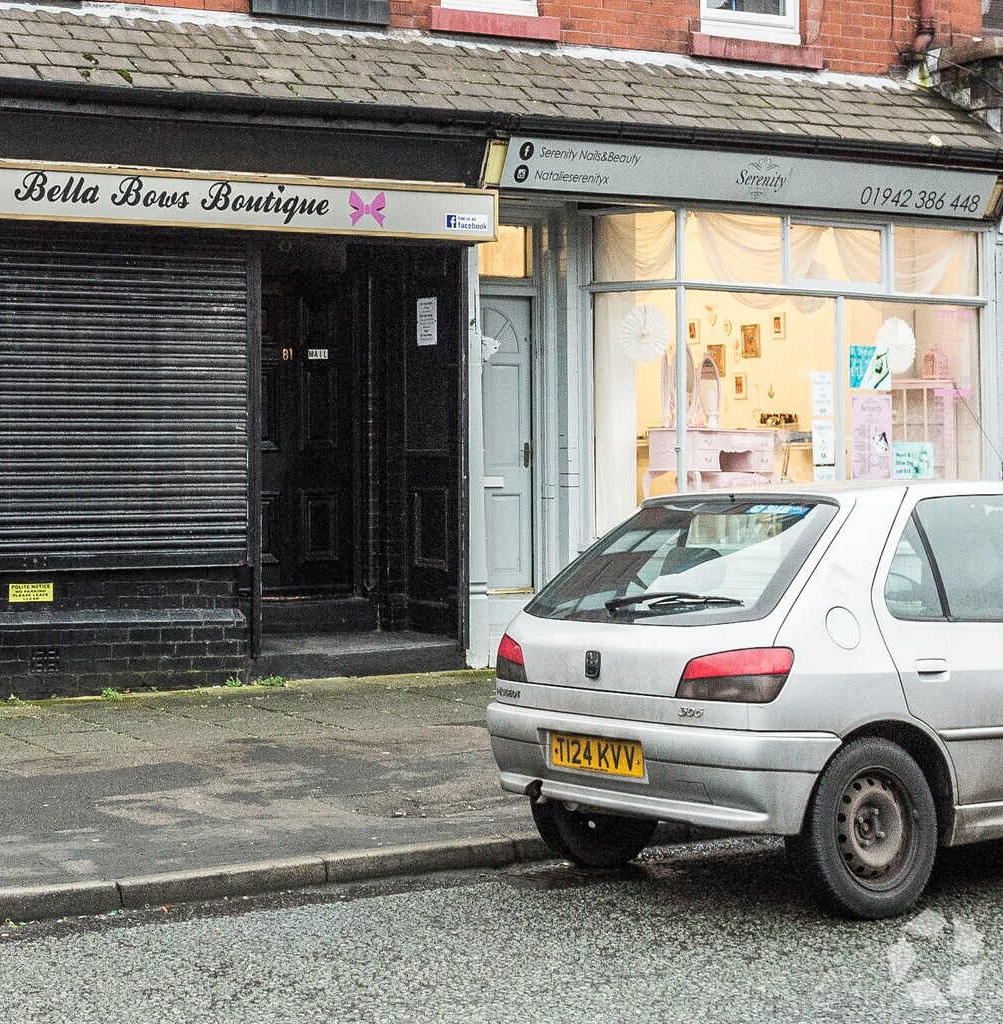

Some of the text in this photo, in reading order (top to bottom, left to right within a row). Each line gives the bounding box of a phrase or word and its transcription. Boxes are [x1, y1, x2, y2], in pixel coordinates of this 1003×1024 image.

[539, 146, 641, 166] Serenity Nails&Beauty
[534, 170, 610, 186] Natalieserenityx
[735, 169, 787, 193] Serenity
[13, 169, 330, 225] Bella Bows Boutique
[860, 186, 981, 213] 01942 386 448
[457, 221, 488, 230] facebook
[282, 347, 293, 361] 81
[308, 350, 327, 358] MAIL
[677, 705, 705, 719] 306
[557, 737, 635, 772] T124 KVV
